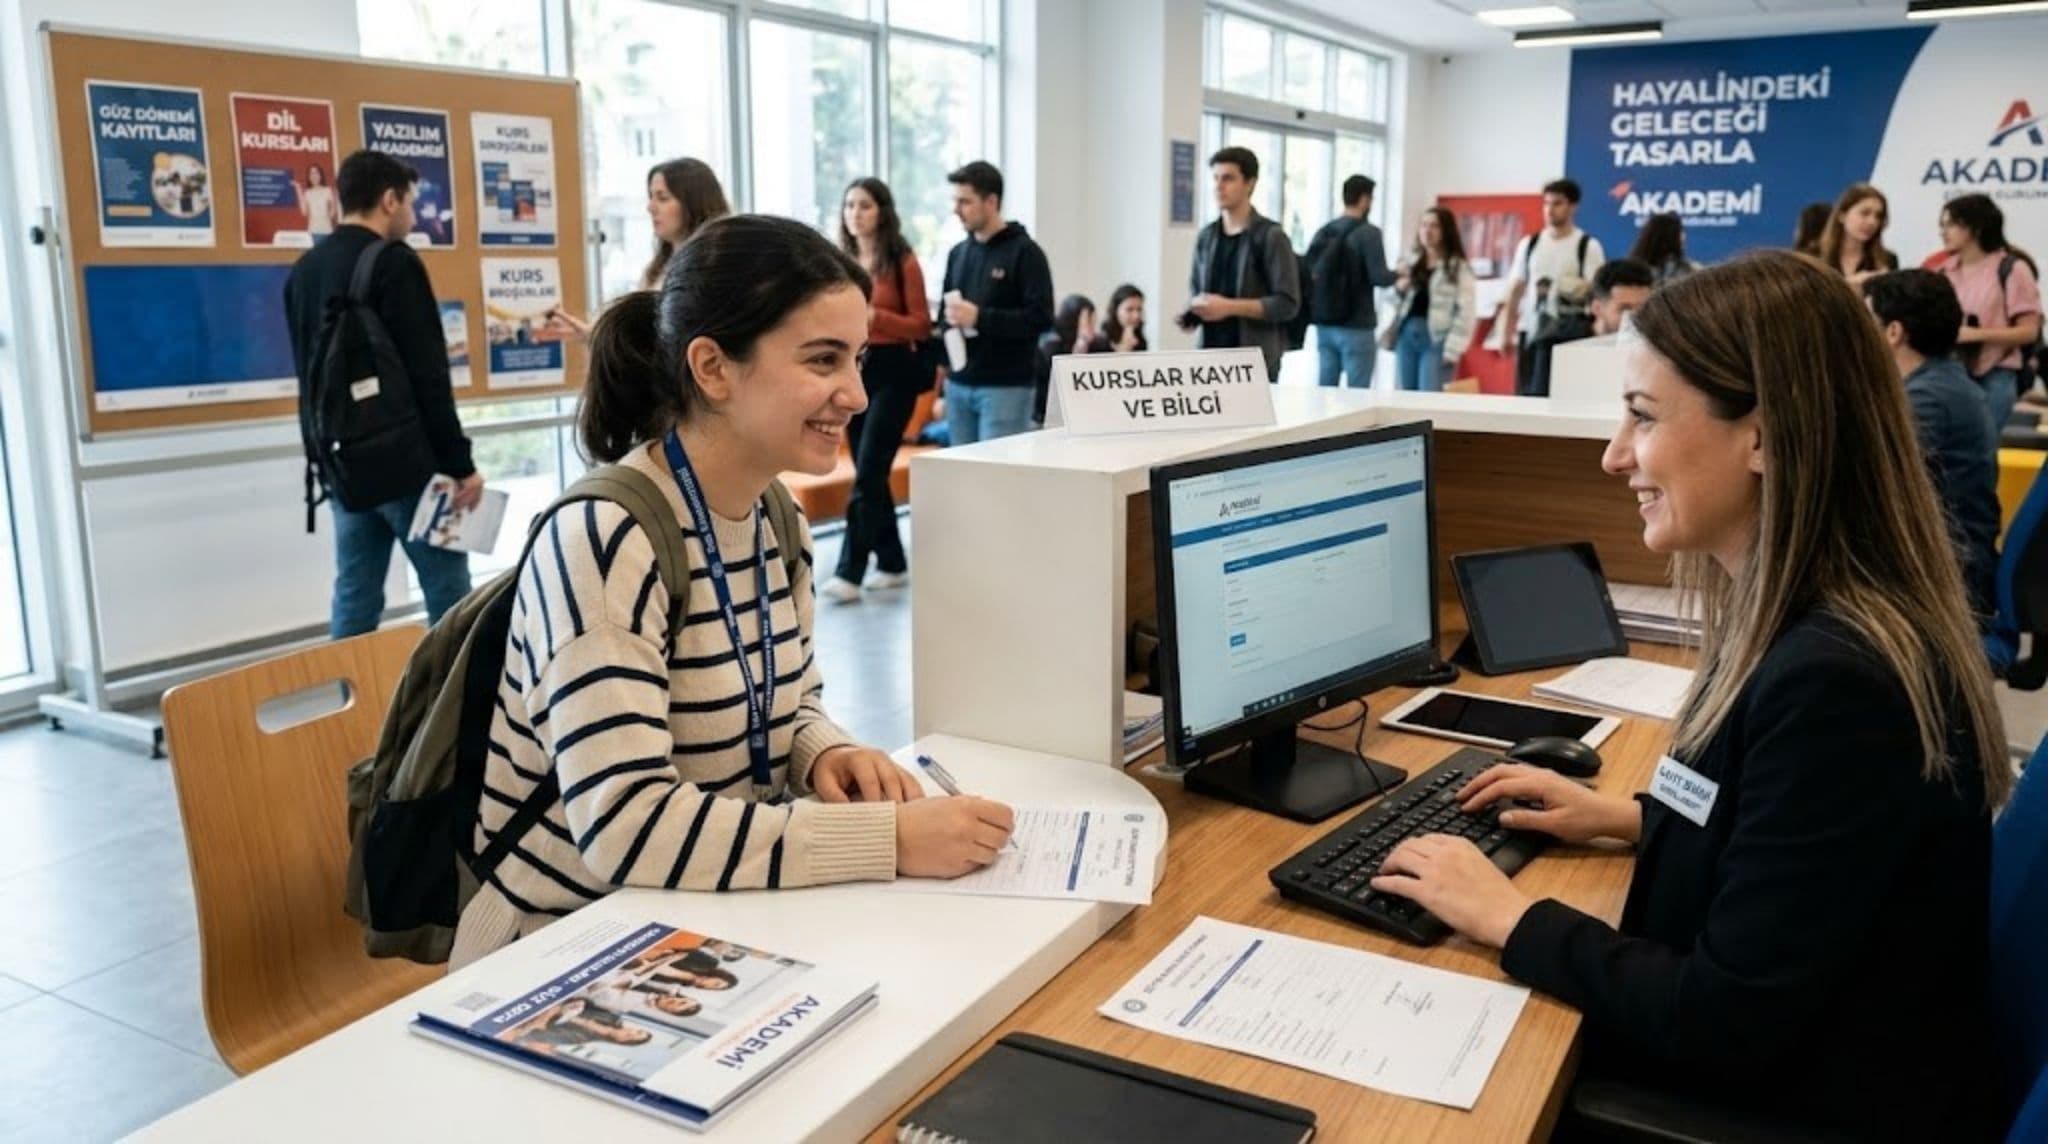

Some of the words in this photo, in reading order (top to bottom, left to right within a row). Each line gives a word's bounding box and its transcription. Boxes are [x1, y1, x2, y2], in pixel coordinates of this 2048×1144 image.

[1612, 66, 1831, 107] HAYALİNDEKİ
[100, 105, 132, 121] GÜZ
[135, 107, 195, 123] DÖNEMİ
[266, 109, 302, 132] DİL
[1610, 102, 1767, 138] GELECEĞİ
[101, 122, 197, 142] KAYITLARI
[241, 131, 329, 152] KURSLARI
[371, 121, 441, 143] YAZILIM
[1610, 139, 1755, 167] TASARLA
[1618, 183, 1763, 216] AKADEMİ
[500, 269, 543, 283] KURS
[1072, 368, 1184, 391] KURSLAR
[1190, 364, 1253, 385] KAYIT
[1123, 399, 1156, 419] VE
[1162, 391, 1222, 417] BİLGİ
[716, 994, 820, 1070] AKADEMİ
